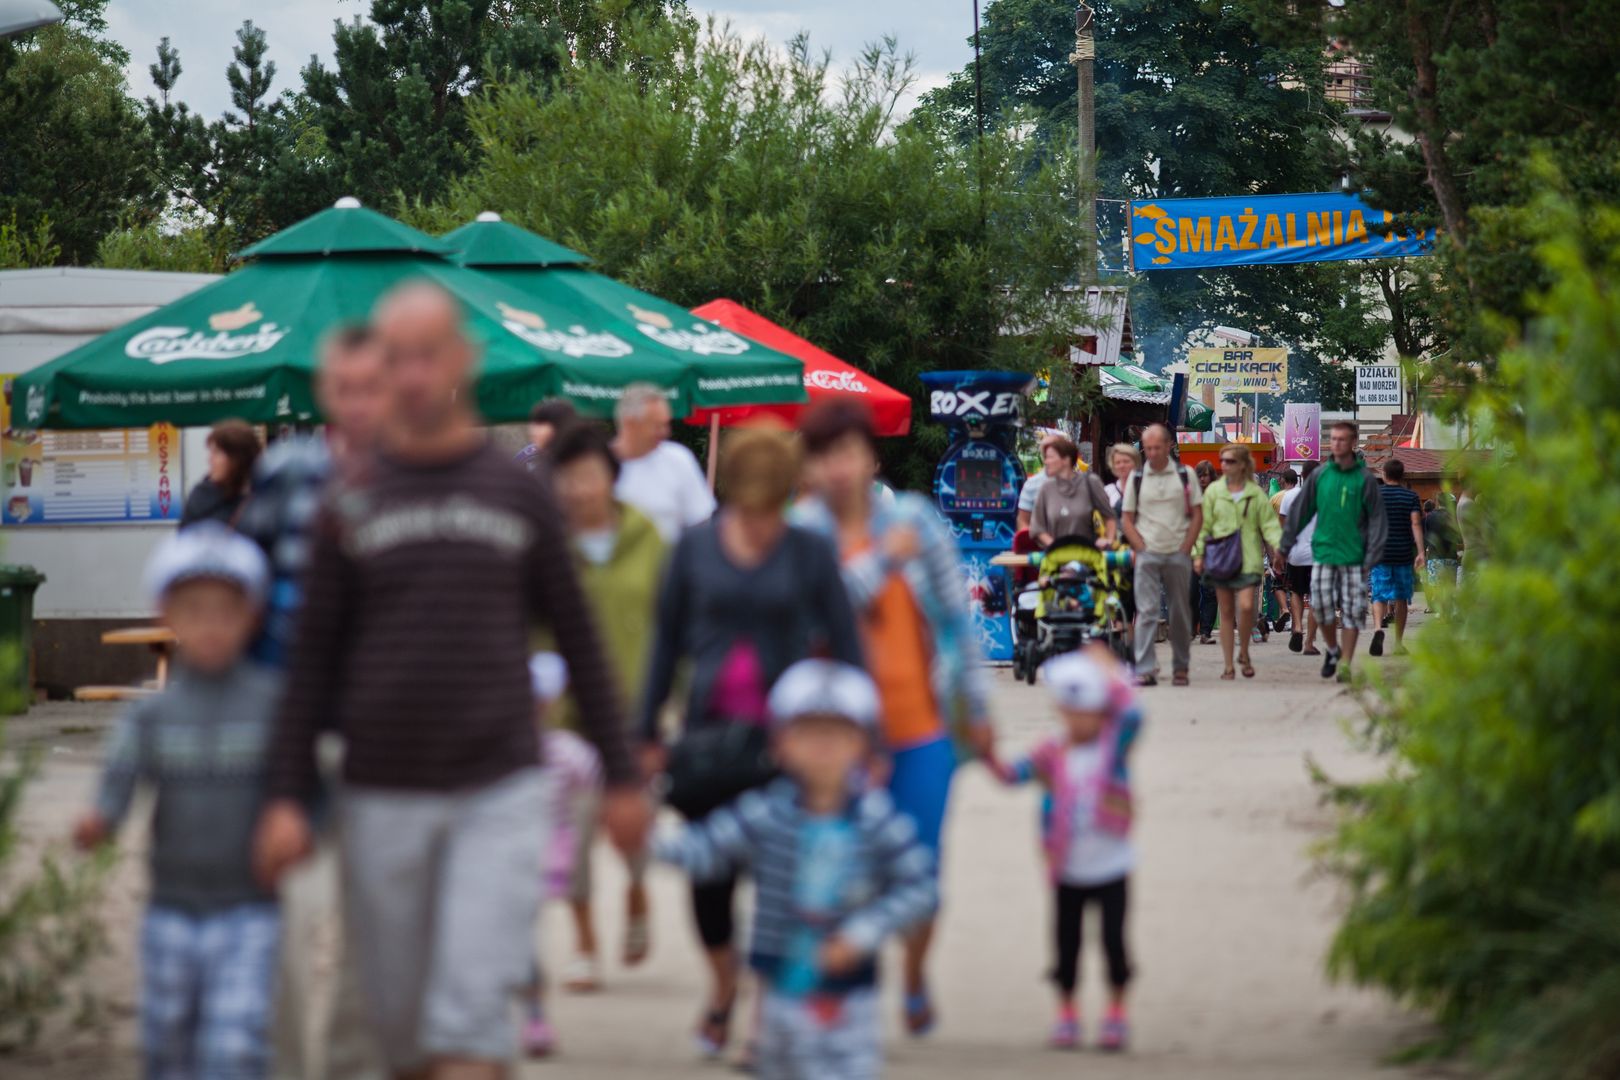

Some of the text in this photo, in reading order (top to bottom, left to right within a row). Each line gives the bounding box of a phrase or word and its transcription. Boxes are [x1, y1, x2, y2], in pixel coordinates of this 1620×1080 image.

[1155, 207, 1369, 254] SMAŻALNIA
[1223, 350, 1254, 361] BAR
[1195, 361, 1238, 373] CICHY
[1360, 367, 1397, 378] DZIAŁKI
[1195, 377, 1268, 387] PIWO WINO
[1359, 381, 1397, 390] NAD MORZEM
